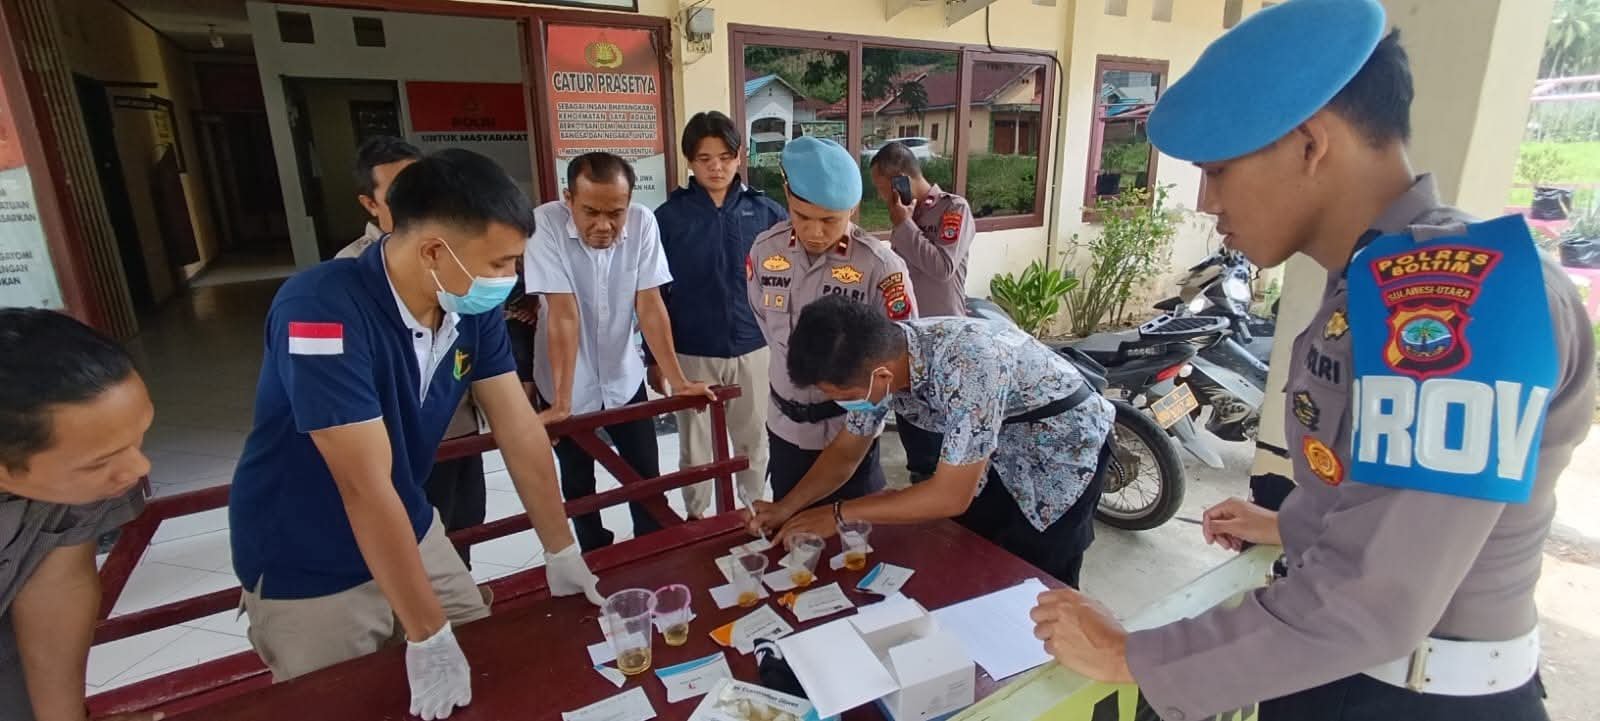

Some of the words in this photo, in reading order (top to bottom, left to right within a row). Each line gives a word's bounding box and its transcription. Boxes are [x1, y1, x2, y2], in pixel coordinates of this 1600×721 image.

[553, 72, 594, 92] CATUR
[598, 73, 656, 94] PRASETYA
[461, 134, 529, 143] MASYARAKAT
[1379, 250, 1489, 272] POLRES
[1391, 262, 1471, 277] BOLTIM
[823, 284, 865, 302] POLRI
